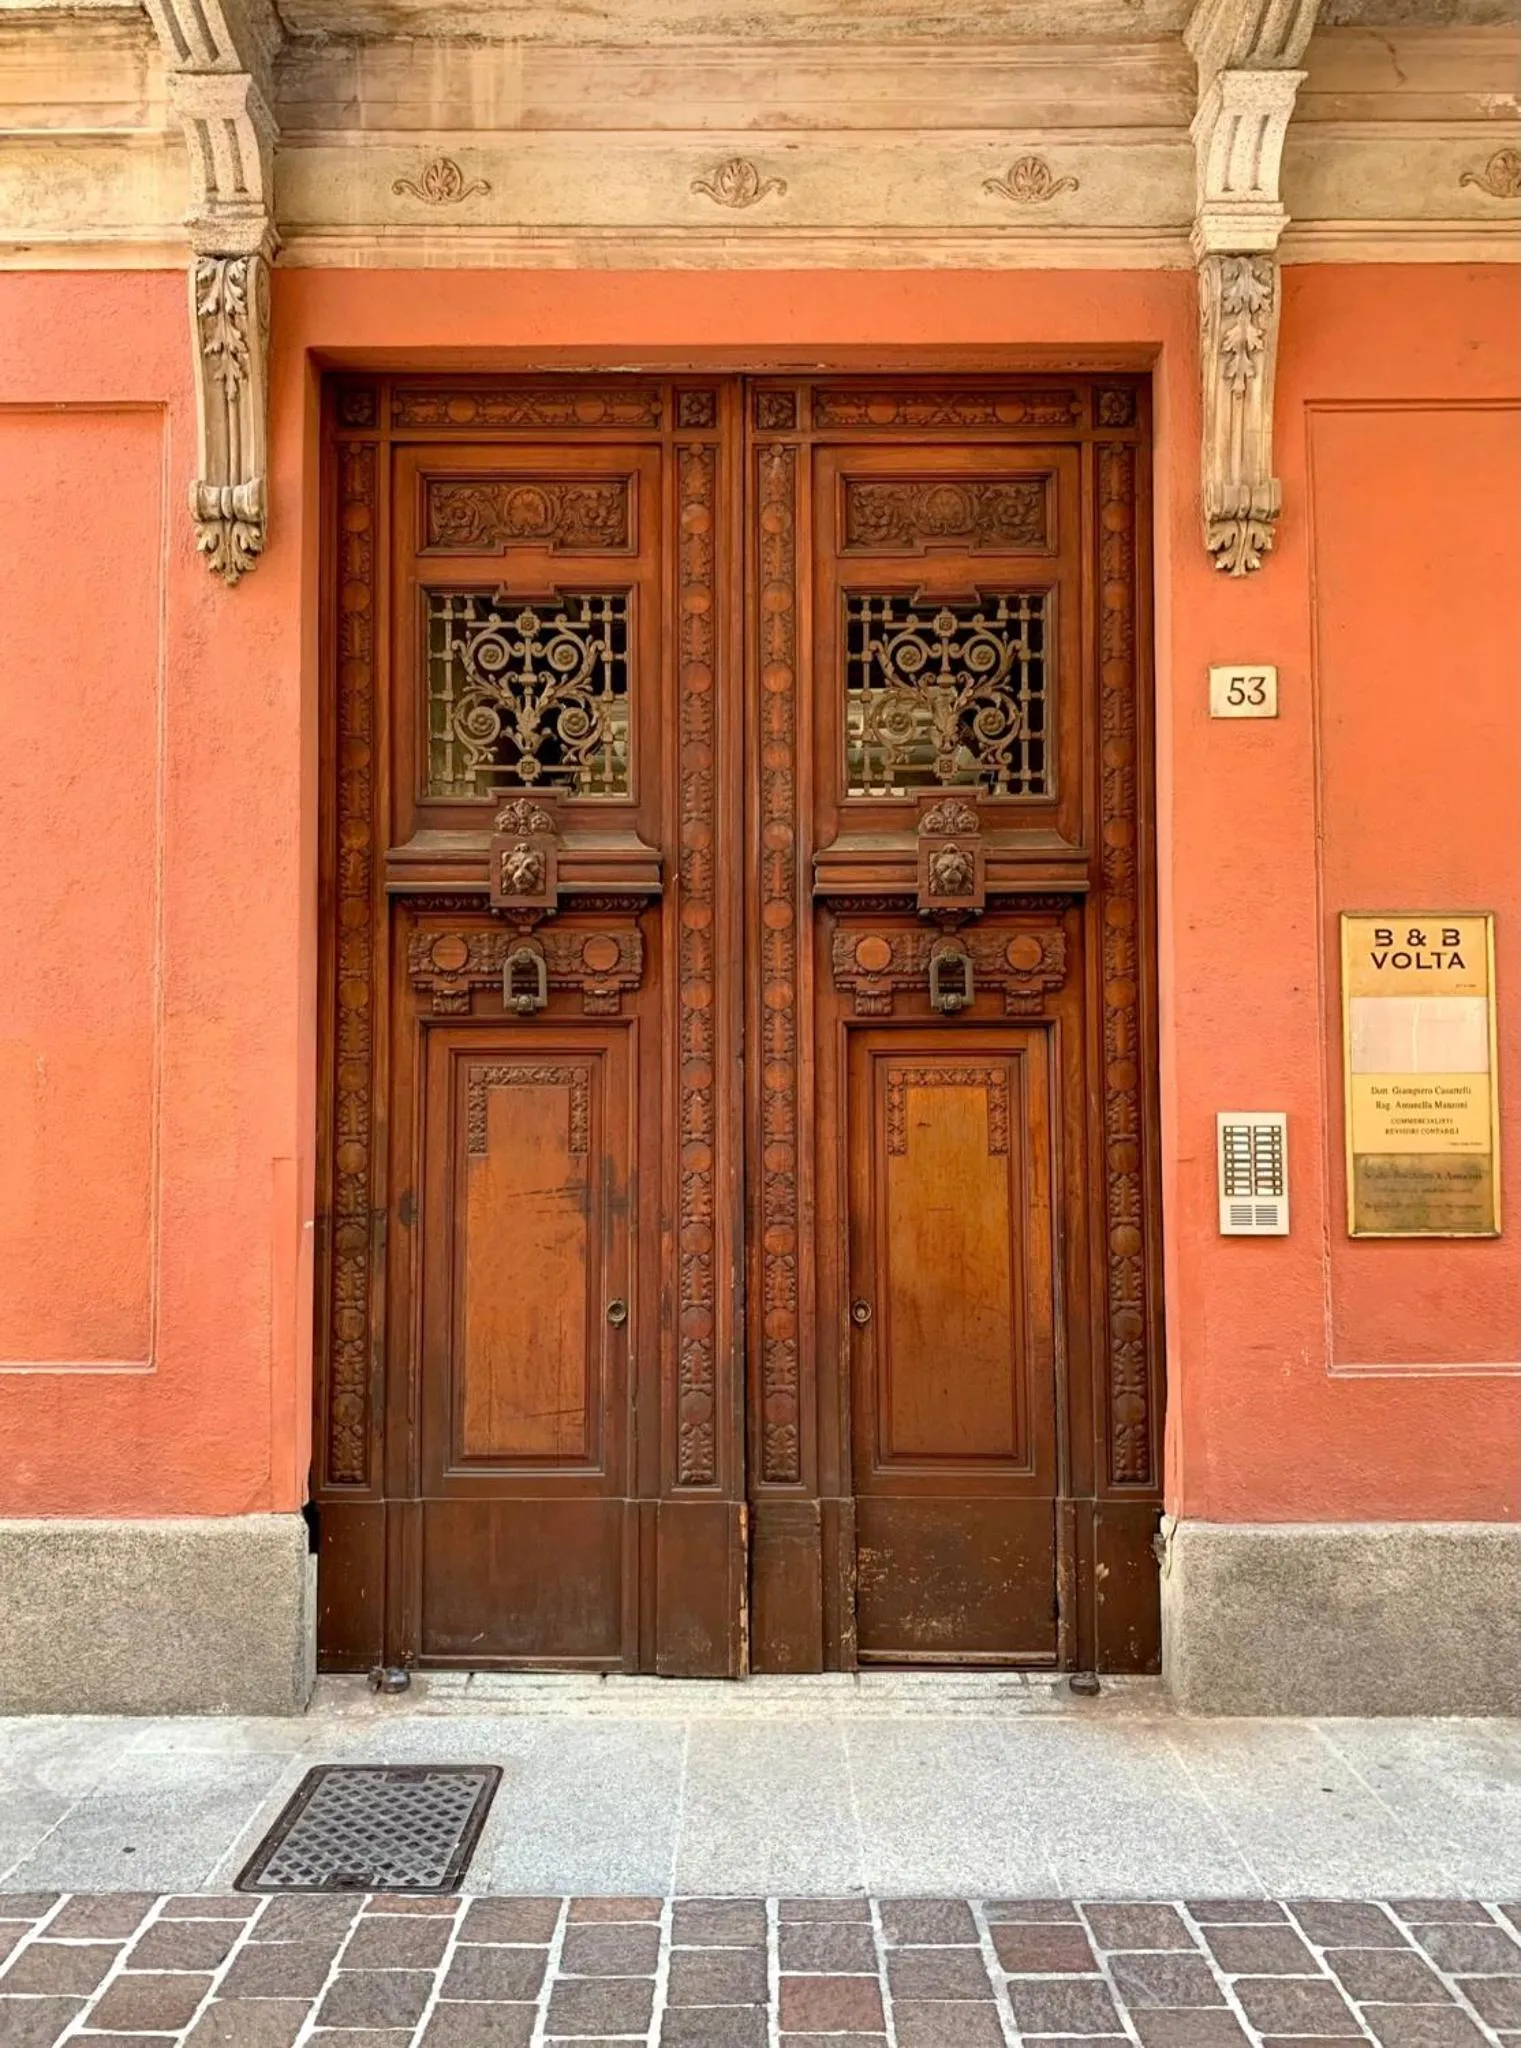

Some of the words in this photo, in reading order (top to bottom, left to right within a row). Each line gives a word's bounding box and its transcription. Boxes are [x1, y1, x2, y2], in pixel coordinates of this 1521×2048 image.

[1227, 676, 1266, 706] 53
[1374, 928, 1394, 947] B
[1406, 928, 1427, 947] &
[1441, 928, 1461, 947] B
[1370, 951, 1466, 970] VOLTA
